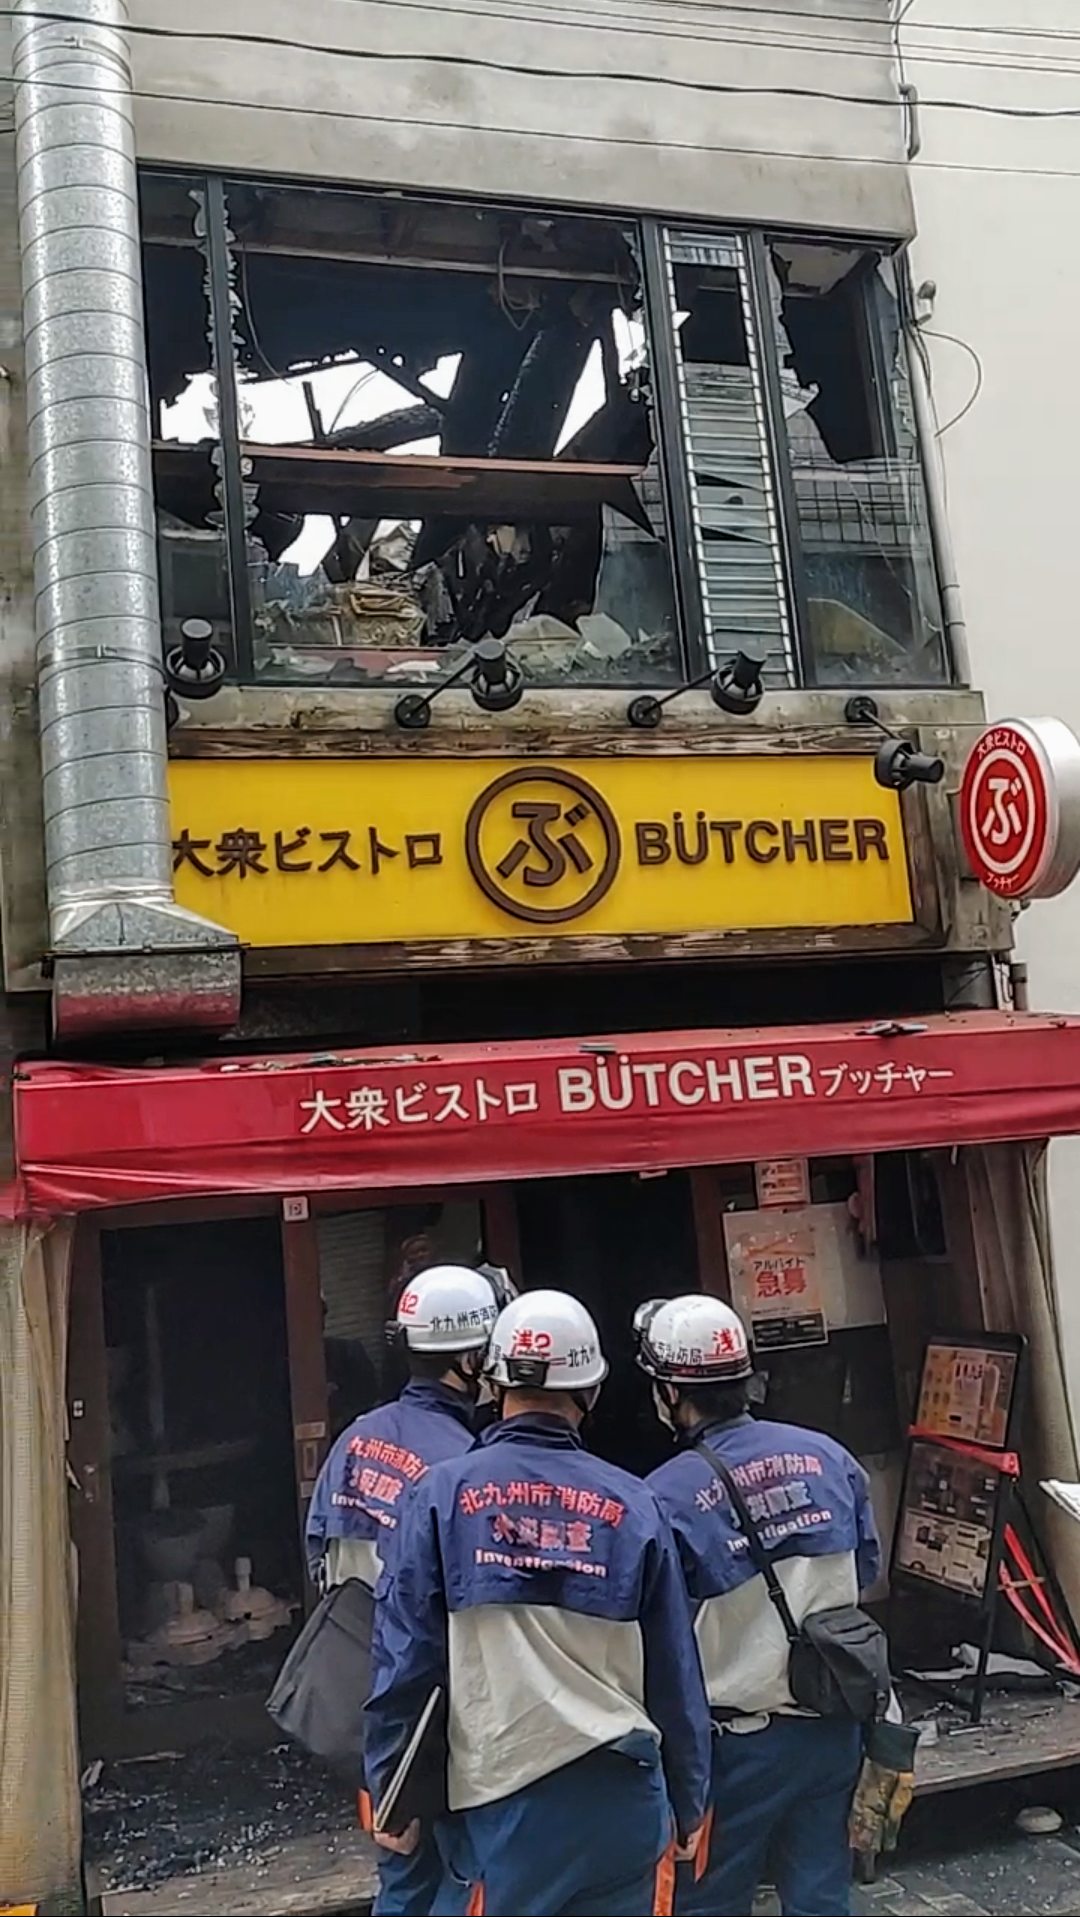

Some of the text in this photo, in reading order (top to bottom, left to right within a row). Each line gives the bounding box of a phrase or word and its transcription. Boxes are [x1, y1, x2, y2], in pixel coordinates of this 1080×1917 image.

[172, 801, 890, 888] 大衆ビストロ ぶ BÜTCHER
[981, 776, 1023, 845] ぶ
[300, 1054, 954, 1134] 大衆ビストロ BÜTCHER ブッチャー
[753, 1257, 806, 1271] アルバイト
[460, 1481, 626, 1528] 北九州市消防局
